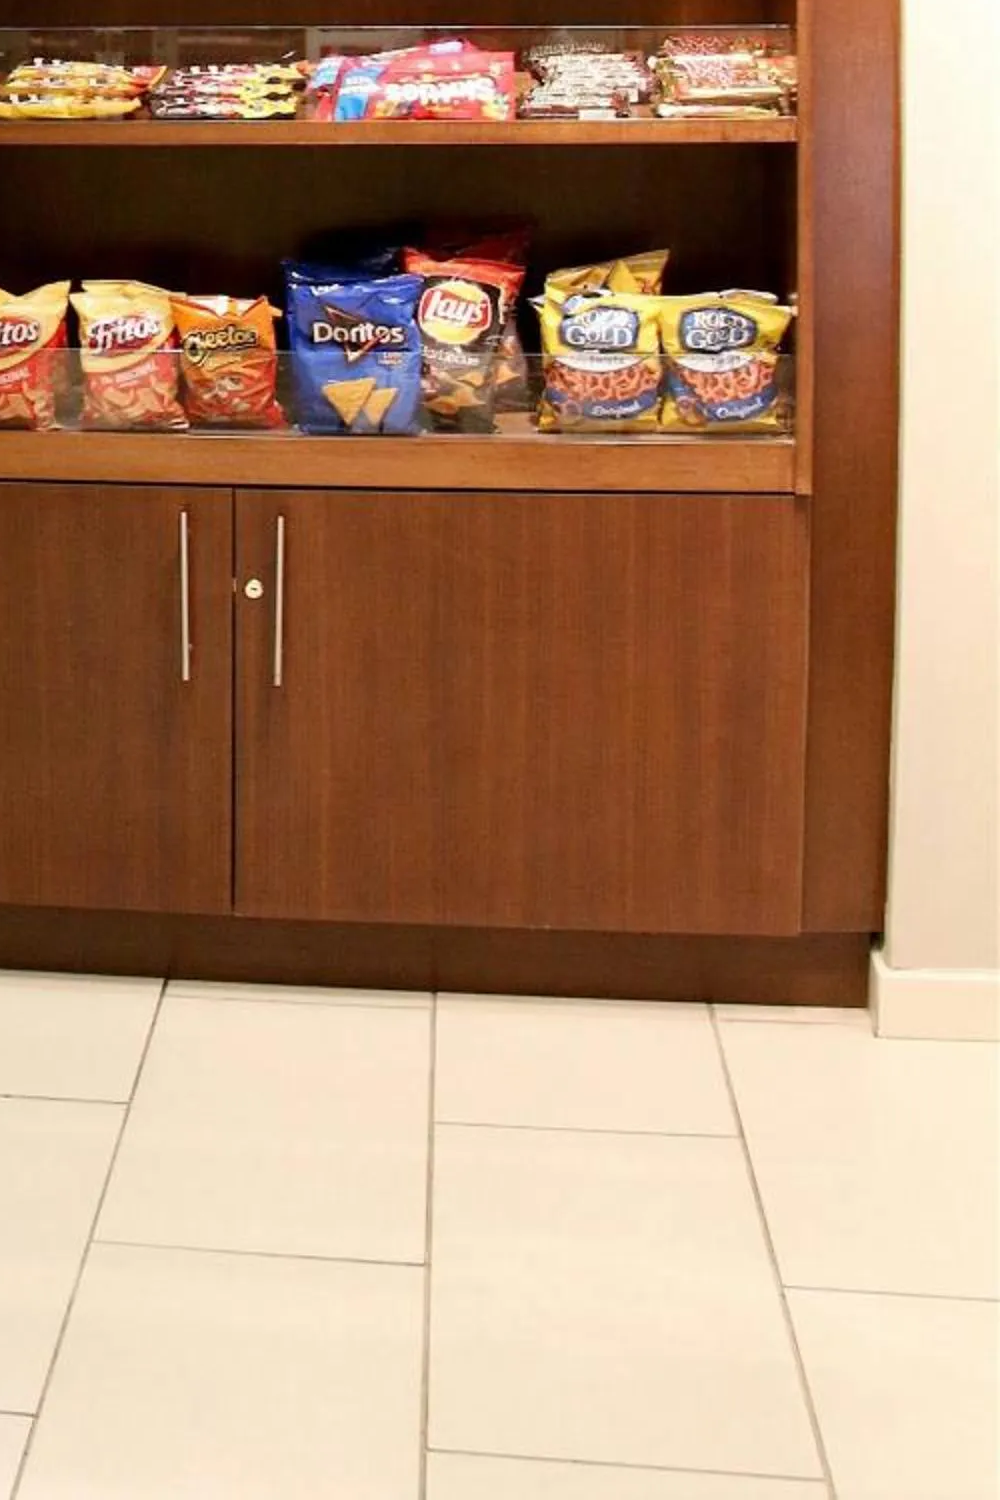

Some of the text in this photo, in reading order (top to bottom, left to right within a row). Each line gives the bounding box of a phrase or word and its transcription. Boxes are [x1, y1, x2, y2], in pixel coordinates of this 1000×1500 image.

[426, 289, 486, 324] Lay's
[89, 316, 161, 354] Fritos
[313, 320, 405, 344] Doritos
[566, 326, 633, 347] GOLD
